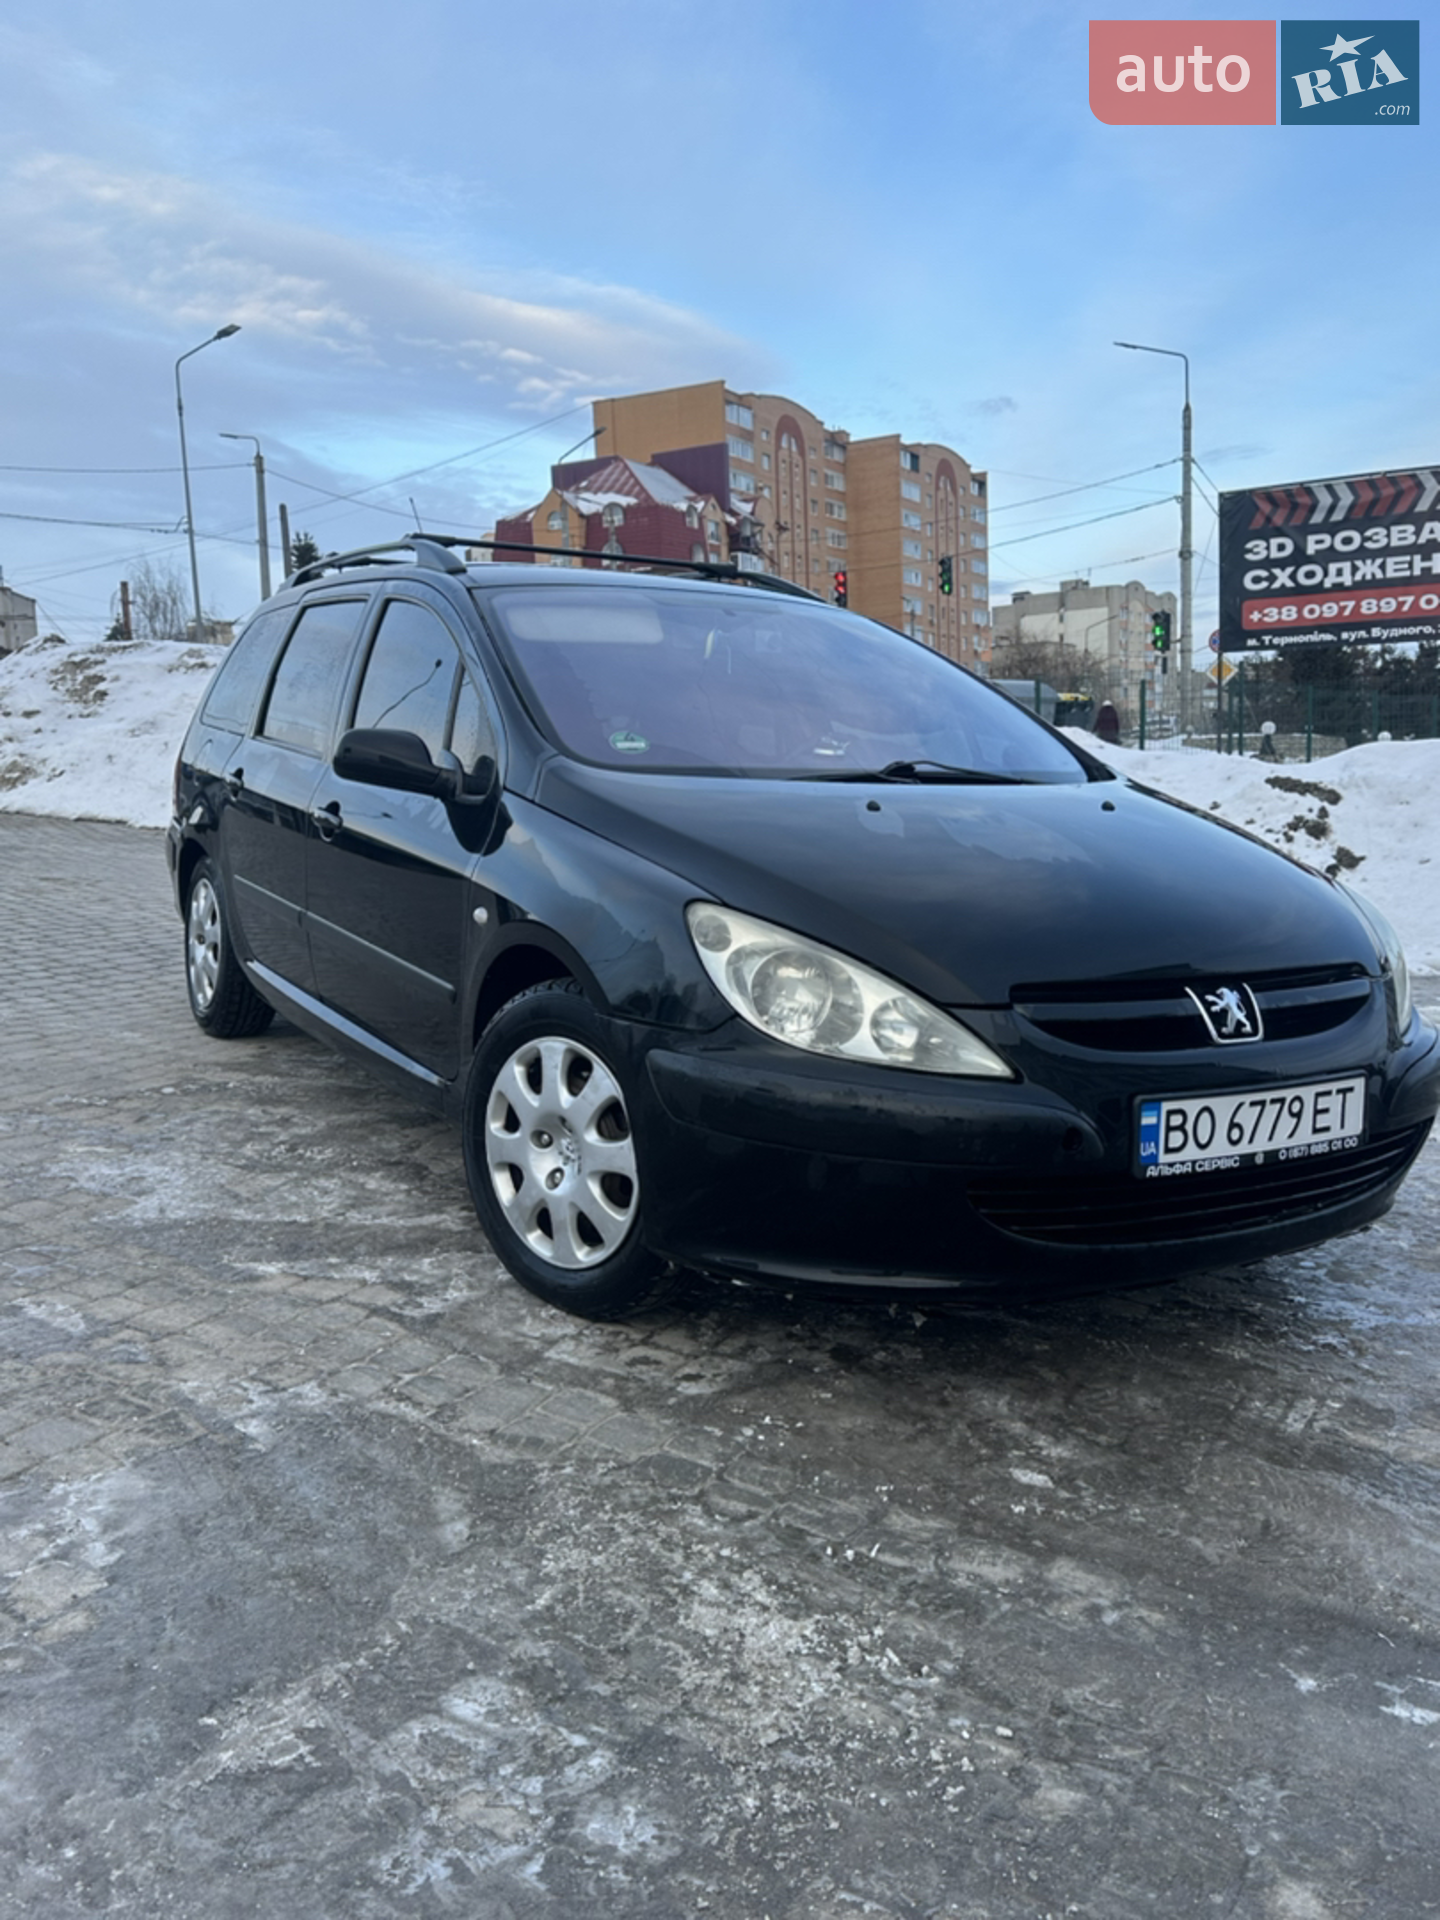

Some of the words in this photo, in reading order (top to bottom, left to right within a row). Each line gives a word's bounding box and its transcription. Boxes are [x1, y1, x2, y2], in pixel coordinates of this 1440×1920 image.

[1244, 537, 1294, 561] 3D
[1243, 552, 1440, 590] СХОДЖЕН
[1249, 605, 1298, 622] +38
[1302, 600, 1356, 619] 097
[1360, 595, 1415, 615] 897
[1341, 627, 1369, 641] вул.
[1371, 624, 1436, 640] Будного,
[1163, 1105, 1216, 1154] BO
[1226, 1095, 1304, 1147] 6779
[1312, 1086, 1355, 1135] ET
[1140, 1141, 1157, 1157] UA
